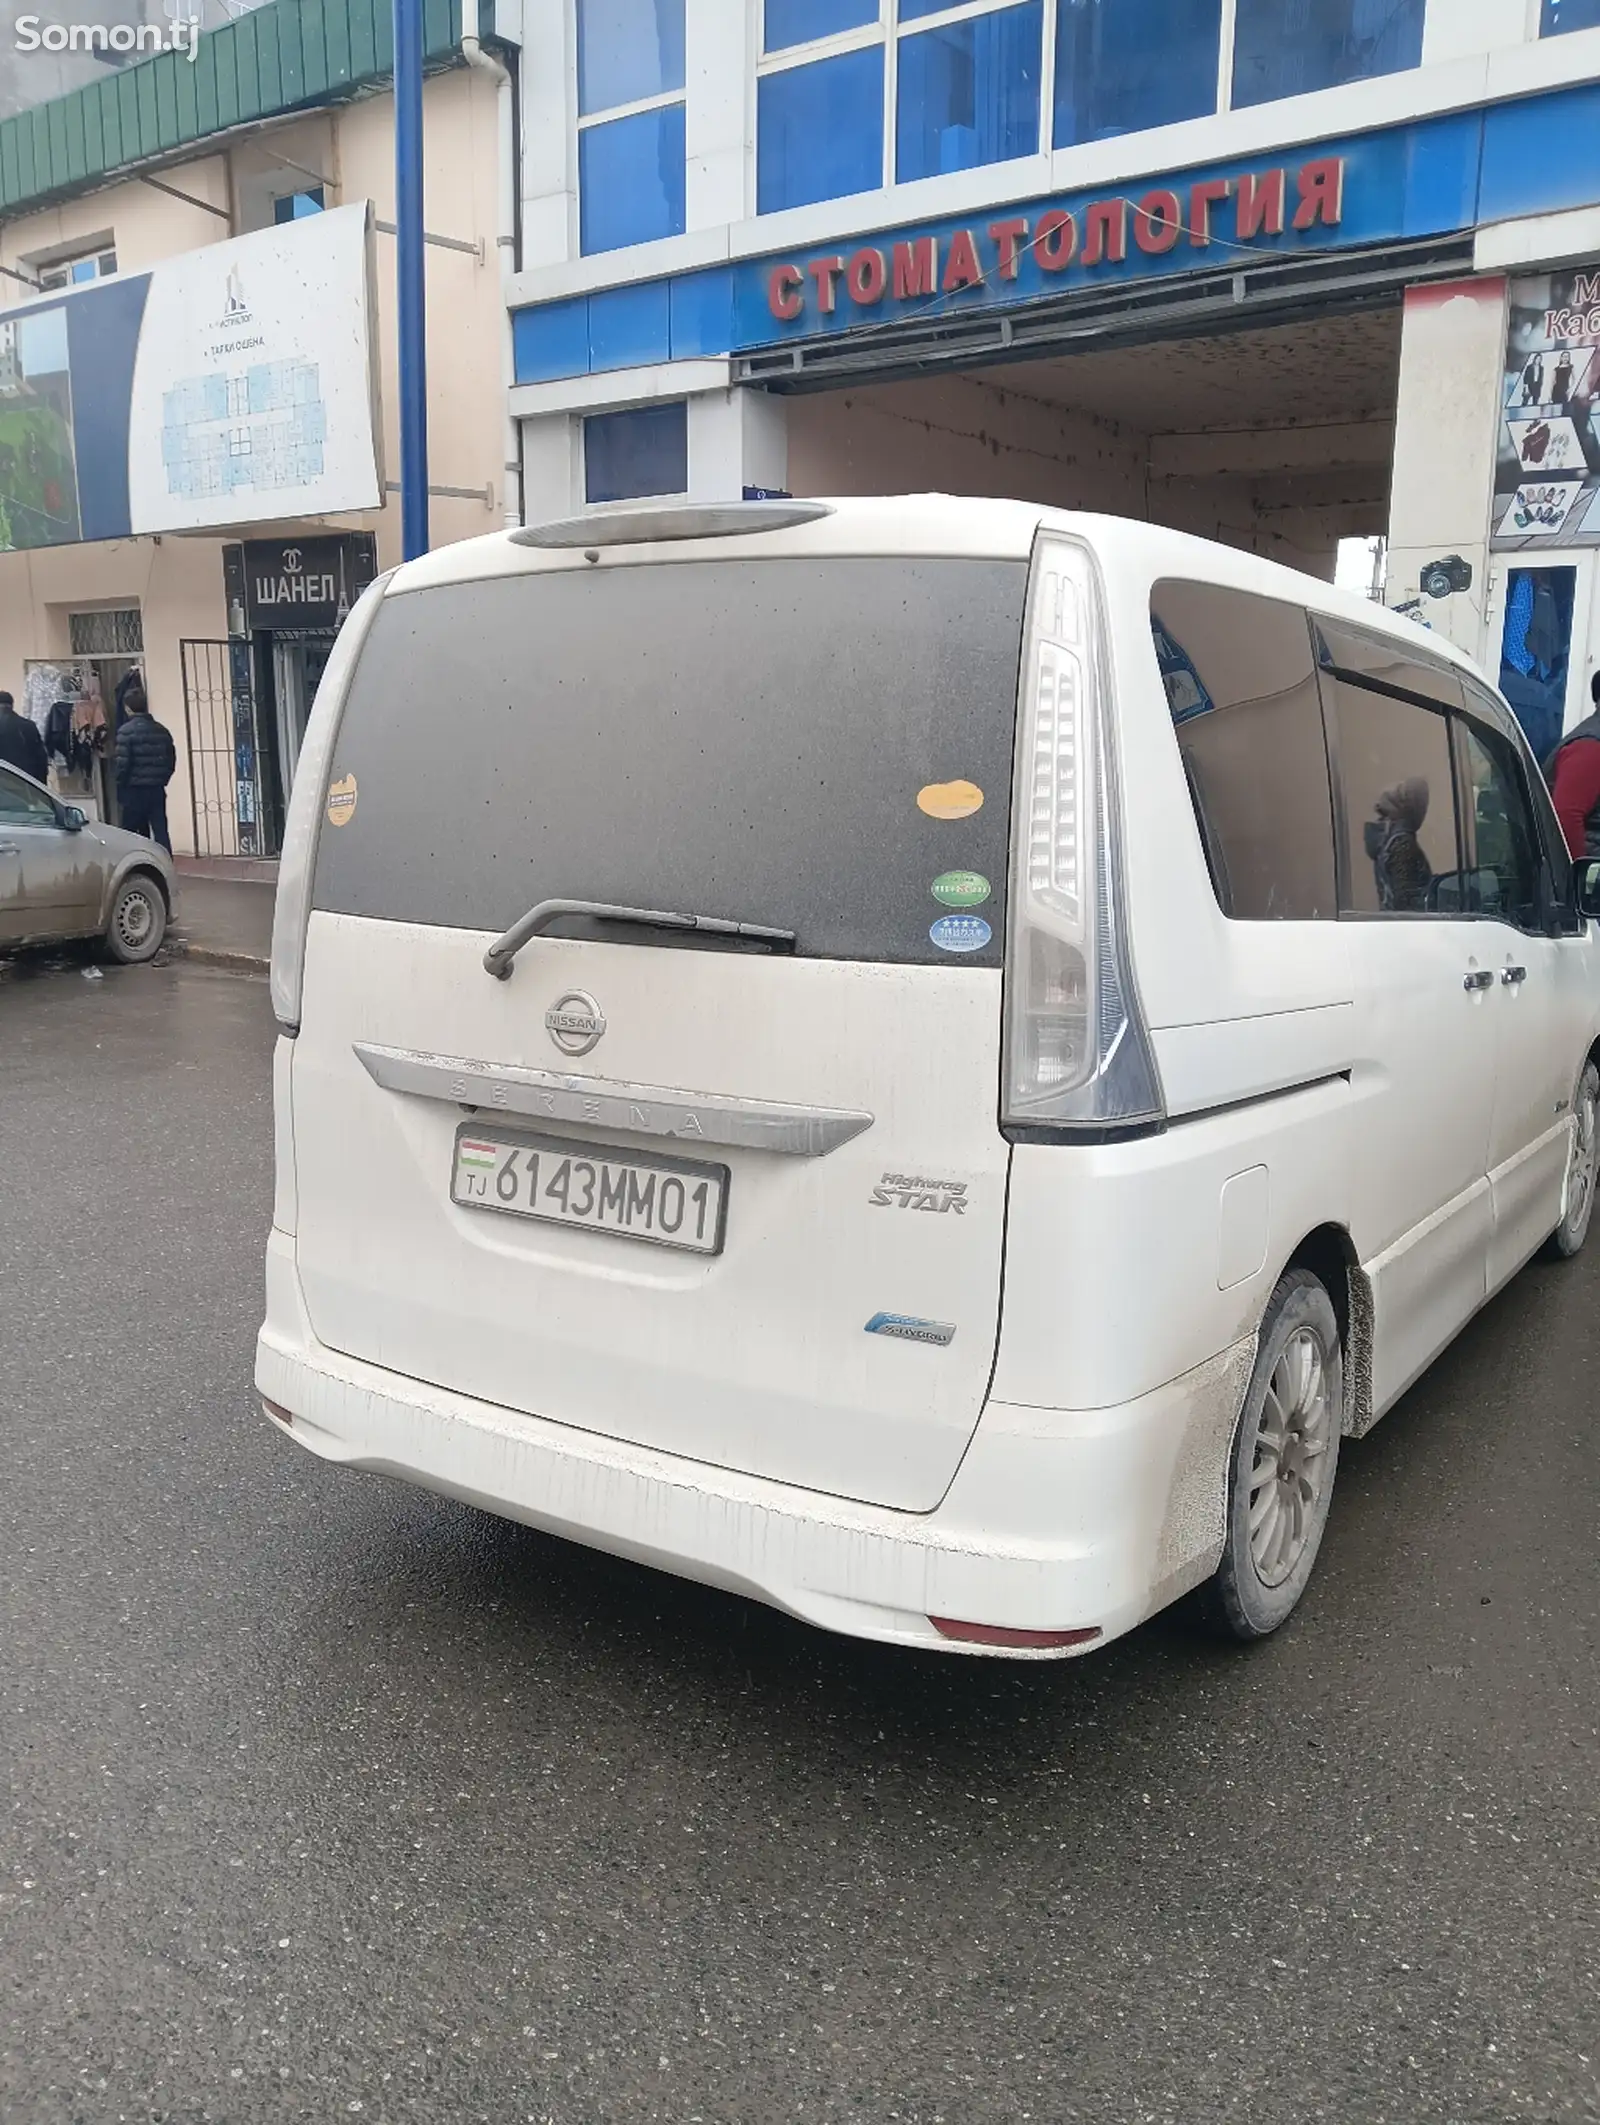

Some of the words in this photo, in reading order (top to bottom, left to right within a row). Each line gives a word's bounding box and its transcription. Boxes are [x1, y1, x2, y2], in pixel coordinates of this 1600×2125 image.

[768, 157, 1345, 320] СТОМАТОЛОГИЯ
[255, 574, 335, 604] ШАНЕЛ
[549, 1014, 597, 1031] NISSAN
[449, 1077, 704, 1136] SERENA
[466, 1173, 488, 1196] TJ
[496, 1149, 709, 1240] 6143MM01
[880, 1172, 968, 1195] Highway
[868, 1185, 969, 1215] STAR
